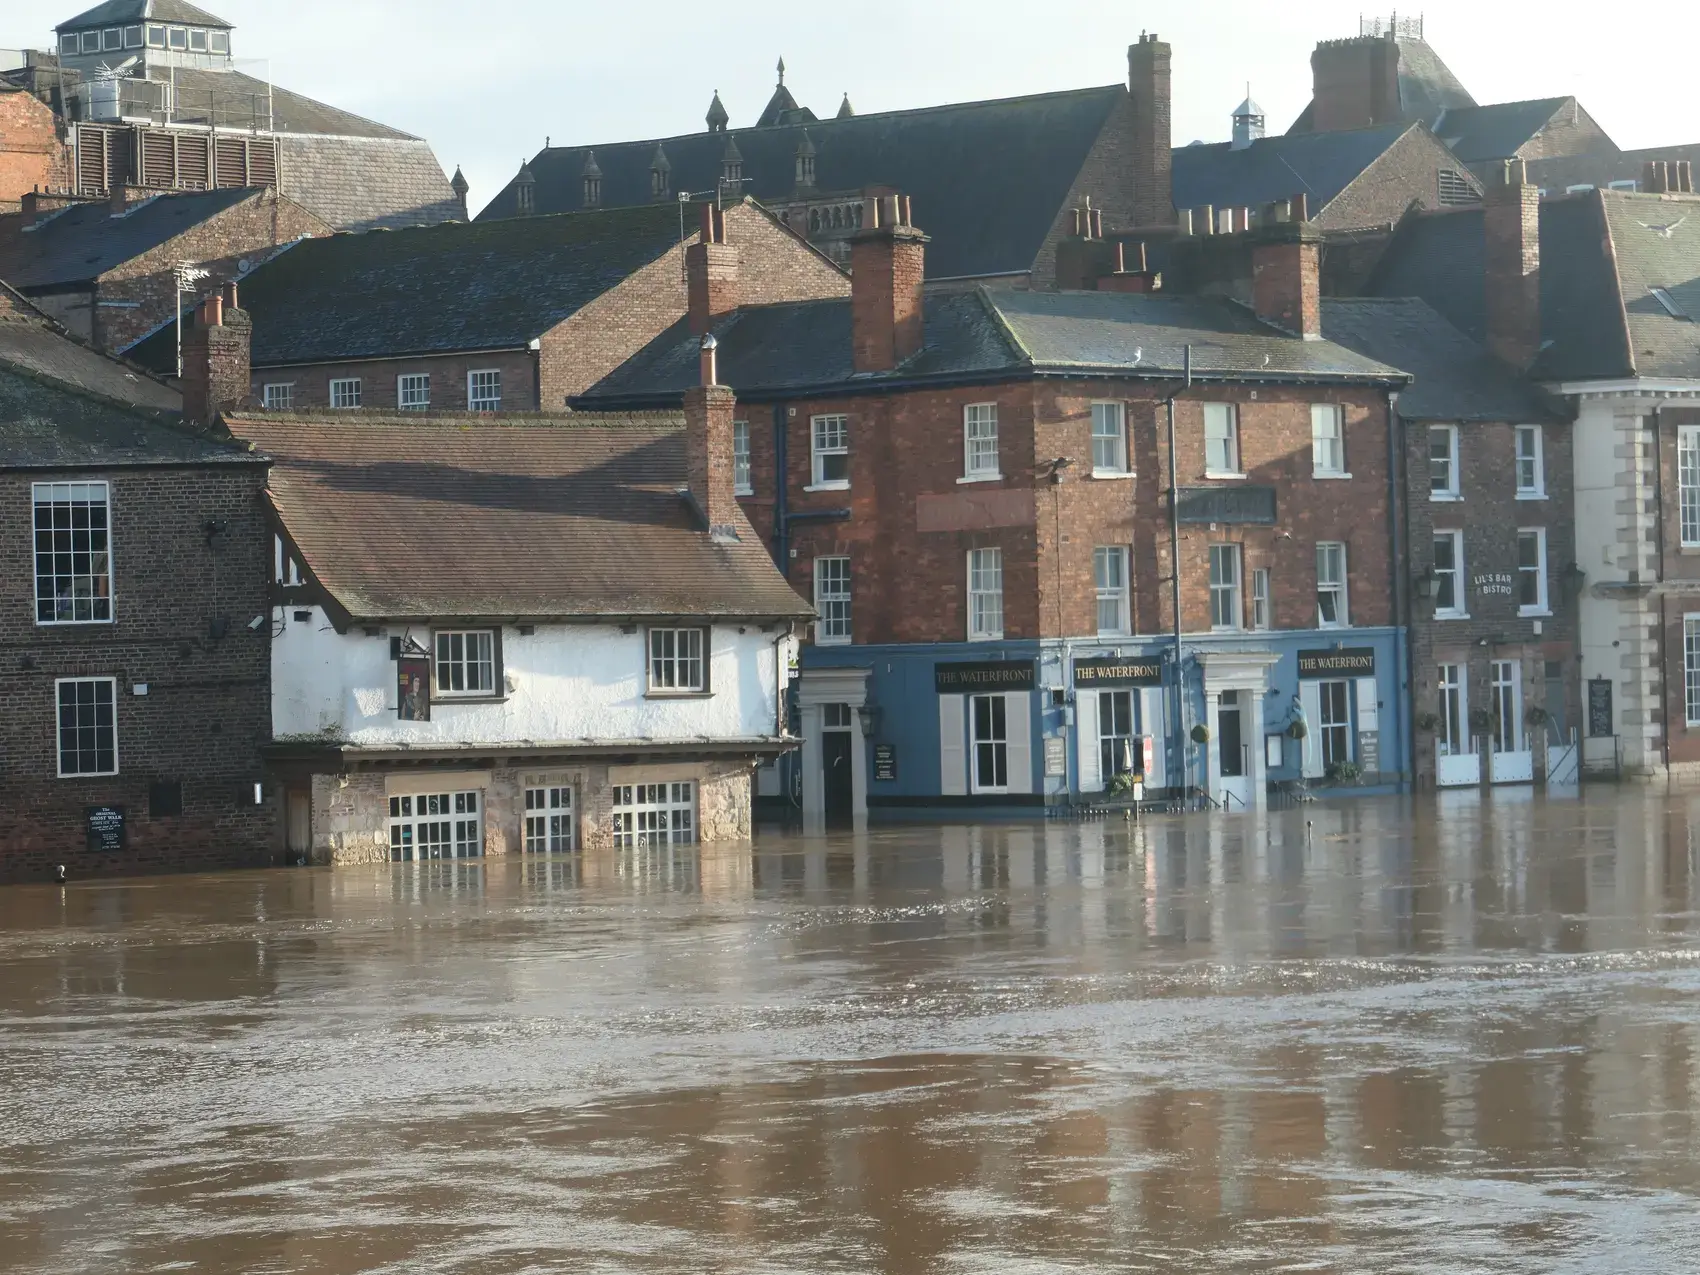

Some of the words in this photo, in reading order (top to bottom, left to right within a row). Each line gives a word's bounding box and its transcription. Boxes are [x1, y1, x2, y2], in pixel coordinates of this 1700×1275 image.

[1474, 573, 1493, 584] LIL'S
[1495, 574, 1512, 583] BAR
[1483, 585, 1512, 595] BISTRO
[1299, 658, 1317, 670] THE
[1317, 656, 1373, 669] WATERFRONT
[936, 671, 956, 683] THE
[959, 669, 1033, 682] WATERFRONT
[1075, 667, 1095, 679] THE
[1096, 665, 1159, 678] WATERFRONT
